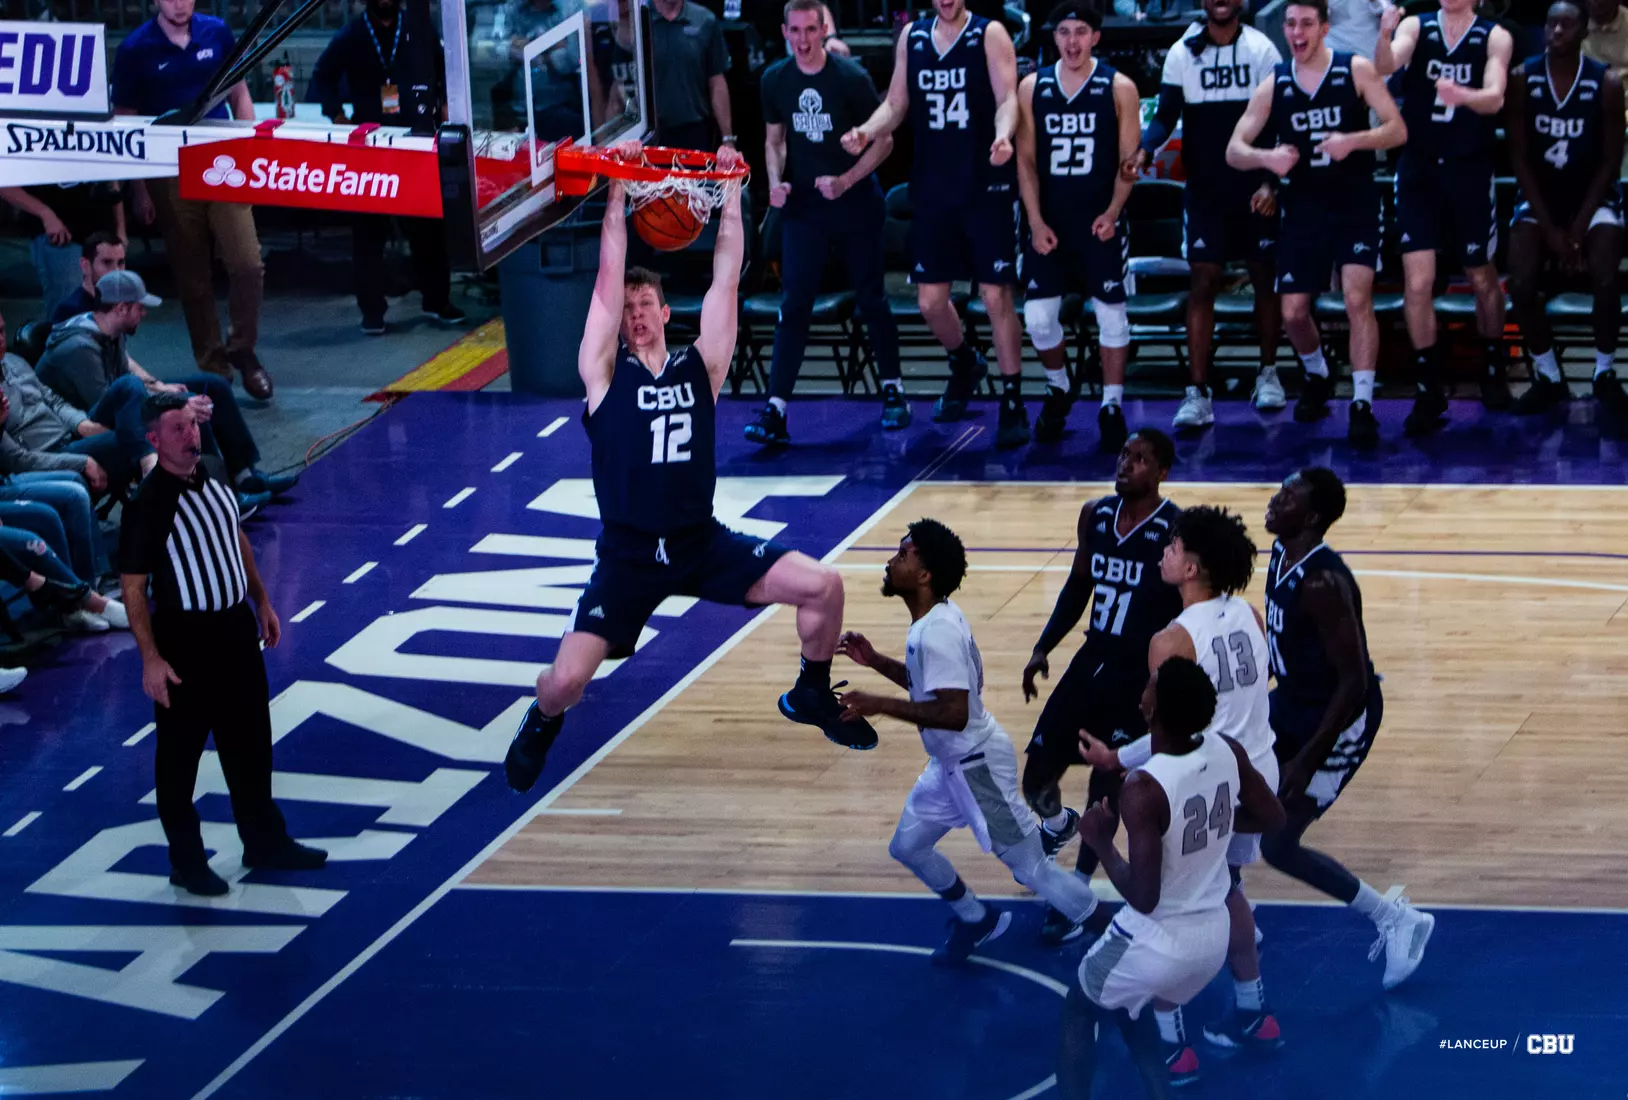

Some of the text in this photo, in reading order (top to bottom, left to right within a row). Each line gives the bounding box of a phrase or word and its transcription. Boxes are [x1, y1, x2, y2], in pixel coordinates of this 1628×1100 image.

[0, 32, 96, 97] EDU
[918, 67, 967, 91] CBU
[1200, 65, 1250, 90] CBU
[1426, 59, 1471, 84] CBU
[926, 92, 969, 130] 34
[1045, 113, 1097, 135] CBU
[1290, 105, 1342, 132] CBU
[1535, 114, 1585, 138] CBU
[6, 123, 146, 160] SPALDING
[1050, 136, 1095, 176] 23
[1310, 131, 1332, 167] 3
[1544, 139, 1569, 169] 4
[637, 382, 695, 411] CBU
[650, 412, 693, 465] 12
[1091, 552, 1144, 588] CBU
[1091, 583, 1133, 636] 31
[1264, 593, 1284, 634] BU
[1211, 630, 1259, 694] 13
[0, 475, 847, 1020] ARIZONA
[1181, 781, 1232, 856] 24
